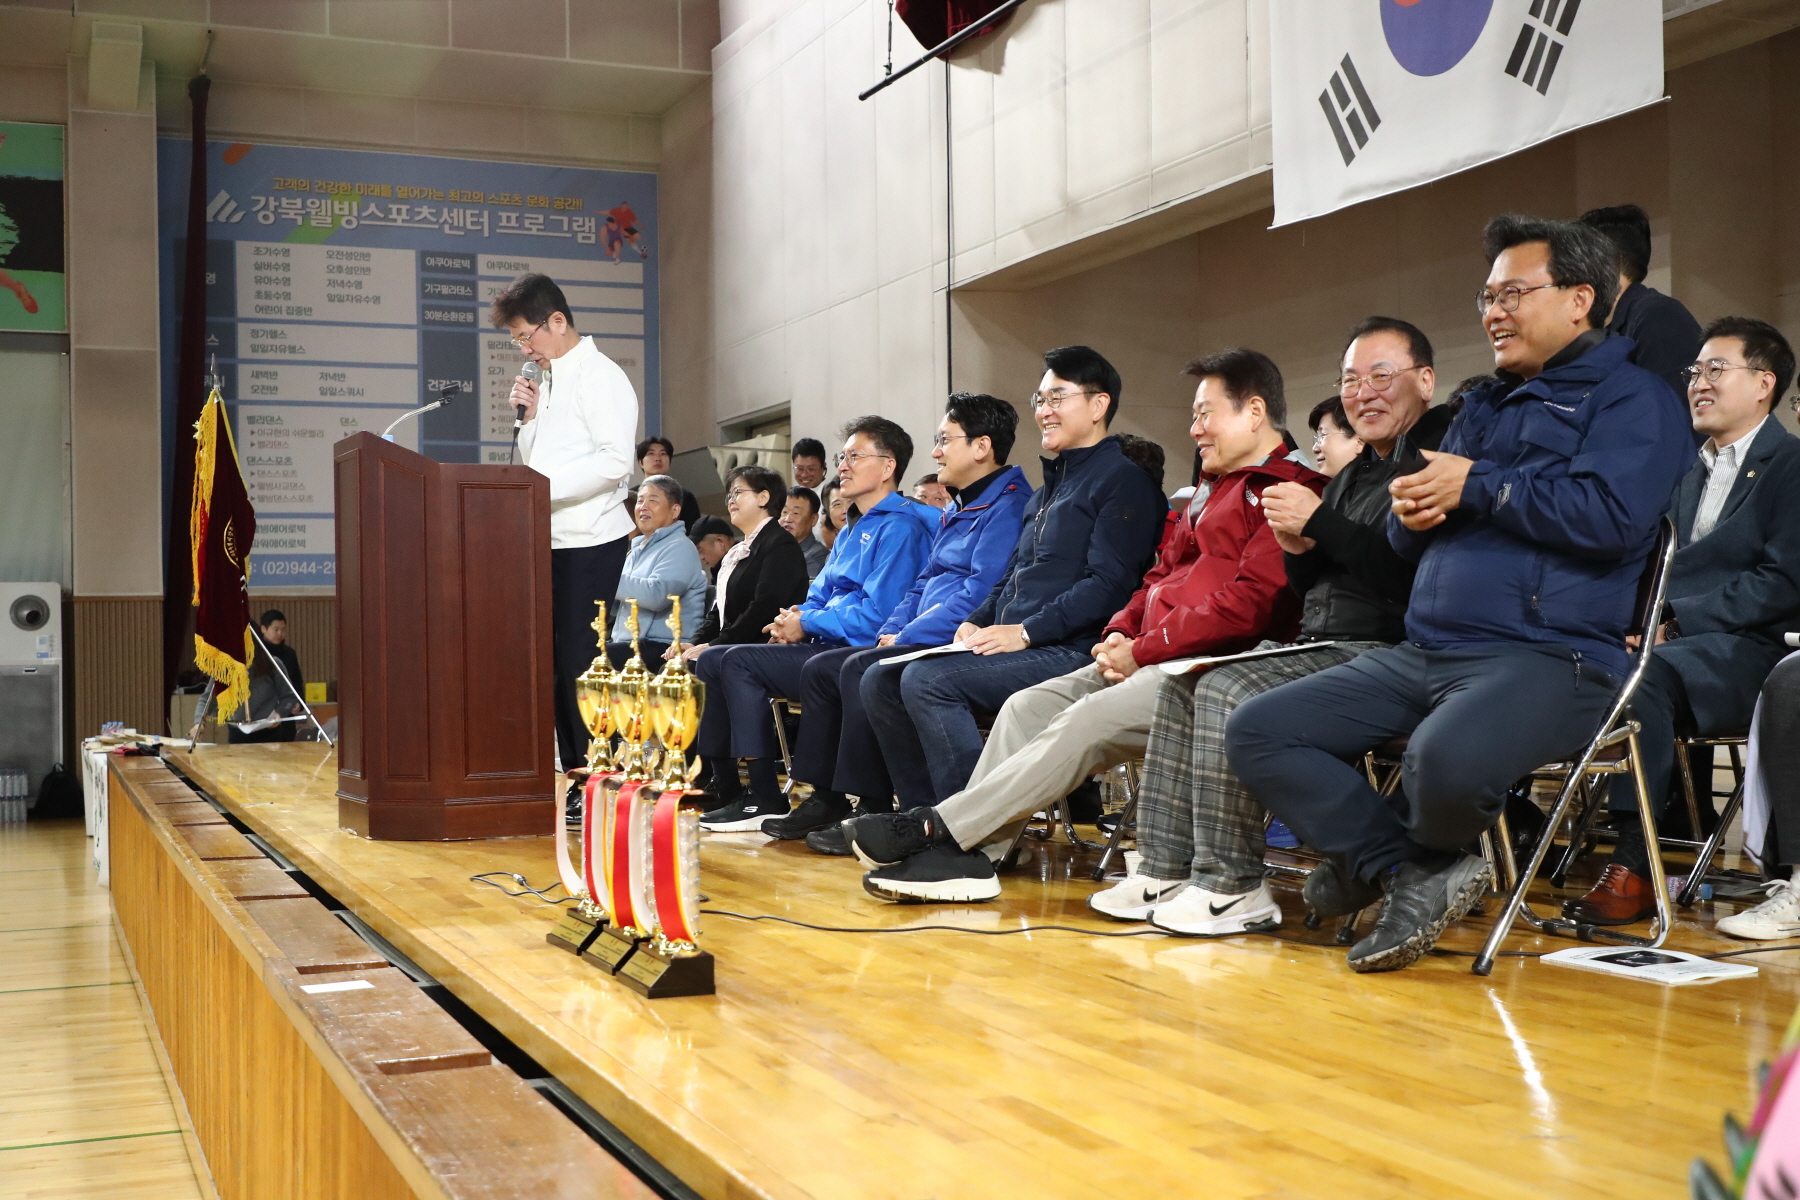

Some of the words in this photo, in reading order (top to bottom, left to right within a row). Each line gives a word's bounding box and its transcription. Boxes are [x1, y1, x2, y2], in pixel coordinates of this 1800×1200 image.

[272, 177, 311, 192] 고객의
[314, 179, 353, 194] 건강한
[355, 182, 393, 198] 미래를
[396, 185, 445, 201] 열어가는
[448, 189, 484, 204] 최고의
[487, 192, 524, 207] 스포츠
[526, 194, 550, 209] 문화
[251, 195, 490, 238] 강북웰빙스포츠센터
[496, 211, 597, 245] 프로그램
[253, 246, 291, 258] 조기수영
[325, 249, 372, 262] 오전성인반
[253, 261, 291, 272] 실버수영
[425, 256, 471, 270] 아쿠아로빅
[486, 260, 530, 272] 아쿠아로빅
[326, 264, 372, 276] 오후성인반
[254, 275, 291, 287] 유아수영
[326, 278, 363, 291] 저녁수영
[254, 290, 292, 301] 초등수영
[424, 283, 473, 297] 기구필라테스
[326, 292, 381, 306] 일일자유수영
[254, 304, 283, 316] 어린이
[285, 305, 313, 317] 집중반
[424, 310, 474, 324] 30분순환운동
[250, 328, 287, 340] 정기헬스
[250, 343, 306, 355] 일일자유헬스
[250, 370, 279, 381] 새벽반
[318, 371, 347, 383] 저녁반
[487, 366, 505, 377] 요가
[250, 384, 279, 396] 오전반
[246, 414, 284, 426] 벨리댄스
[339, 416, 359, 427] 댄스
[257, 439, 290, 450] 벨리댄스
[246, 455, 294, 467] 댄스스포츠
[257, 468, 298, 479] 댄스스포츠
